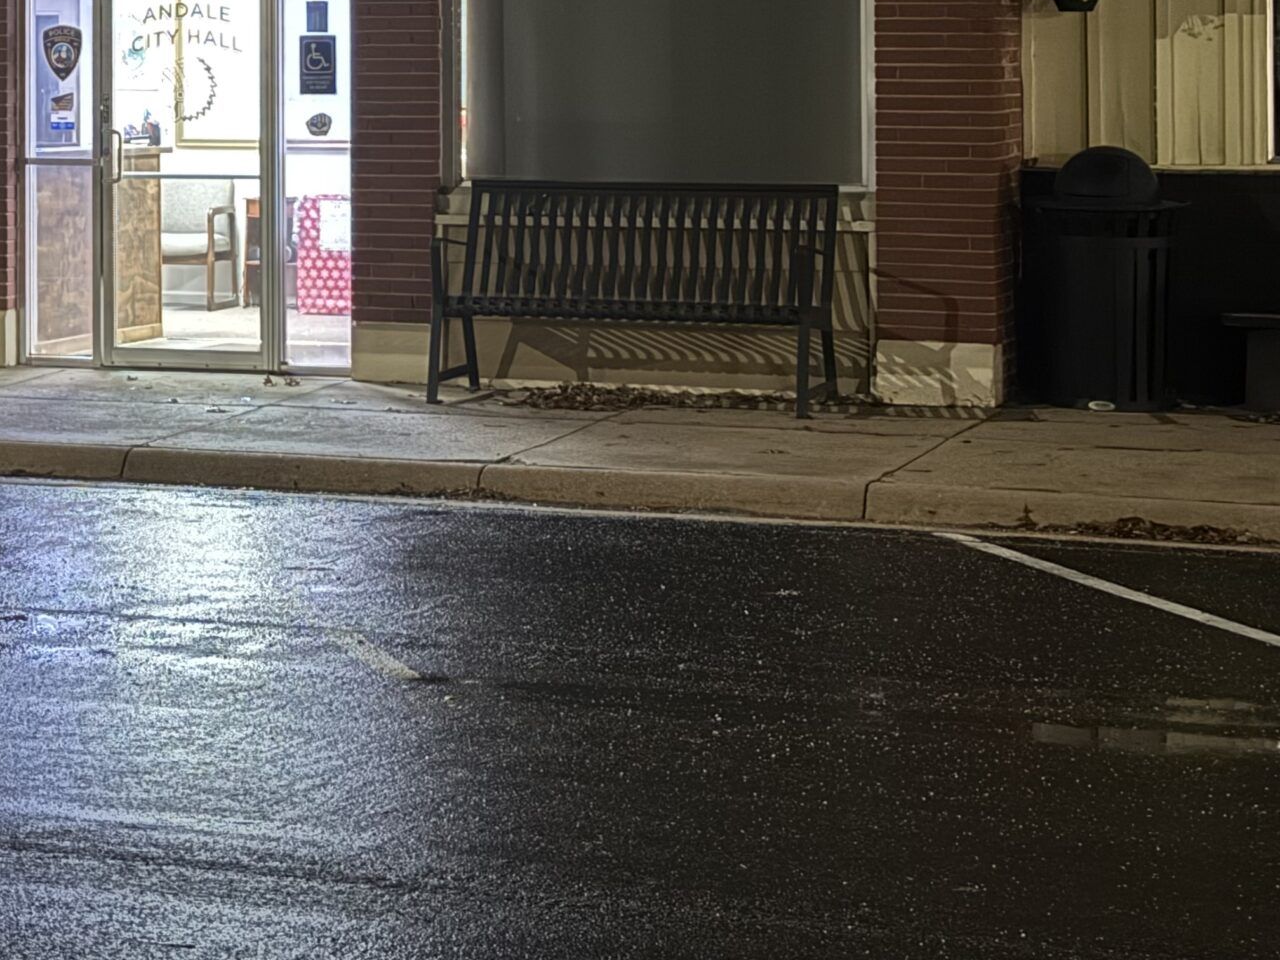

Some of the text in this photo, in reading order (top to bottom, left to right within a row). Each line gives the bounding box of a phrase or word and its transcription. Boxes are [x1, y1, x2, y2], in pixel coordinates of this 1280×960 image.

[142, 2, 232, 24] ANDALE
[48, 28, 75, 37] POLICE
[132, 28, 243, 54] CITY HALL
